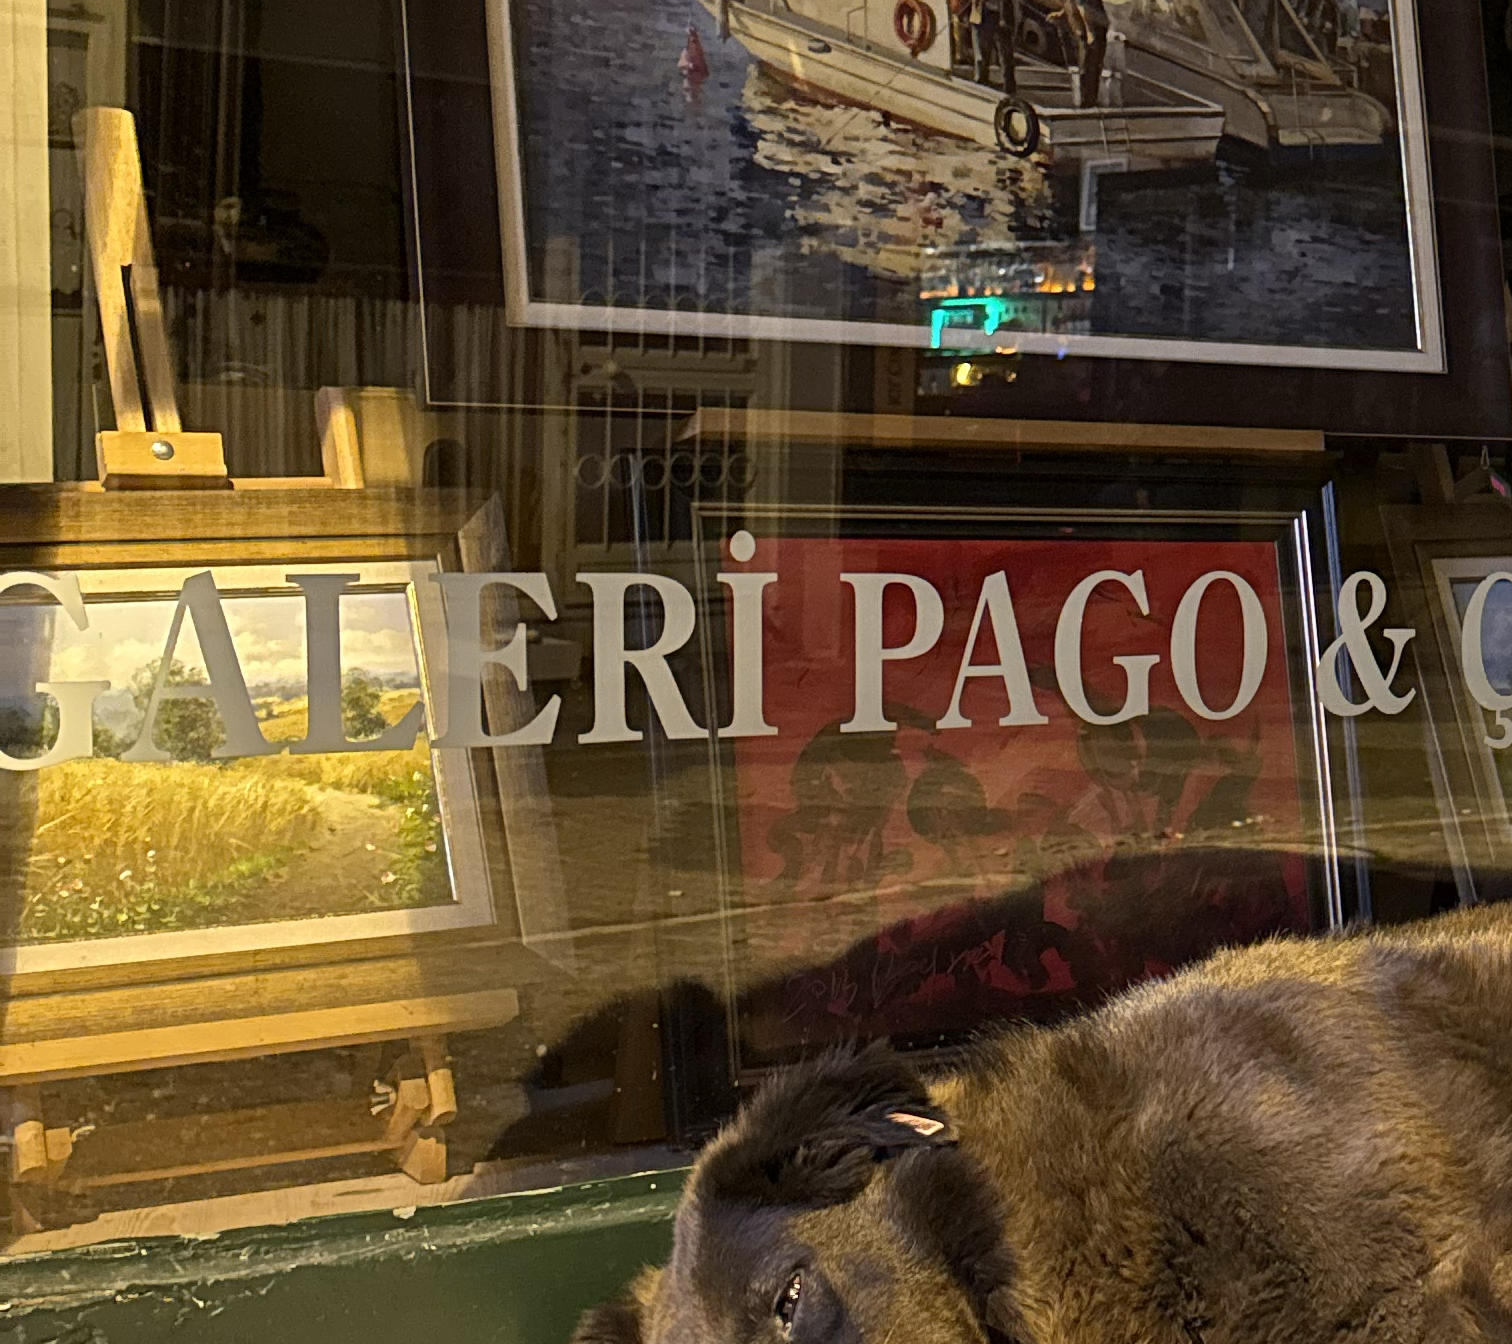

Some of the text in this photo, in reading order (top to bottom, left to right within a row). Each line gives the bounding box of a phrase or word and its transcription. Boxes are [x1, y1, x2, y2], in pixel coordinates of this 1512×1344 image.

[0, 529, 779, 772] GALERİ
[838, 568, 1269, 734] PAGO
[1316, 569, 1417, 717] &
